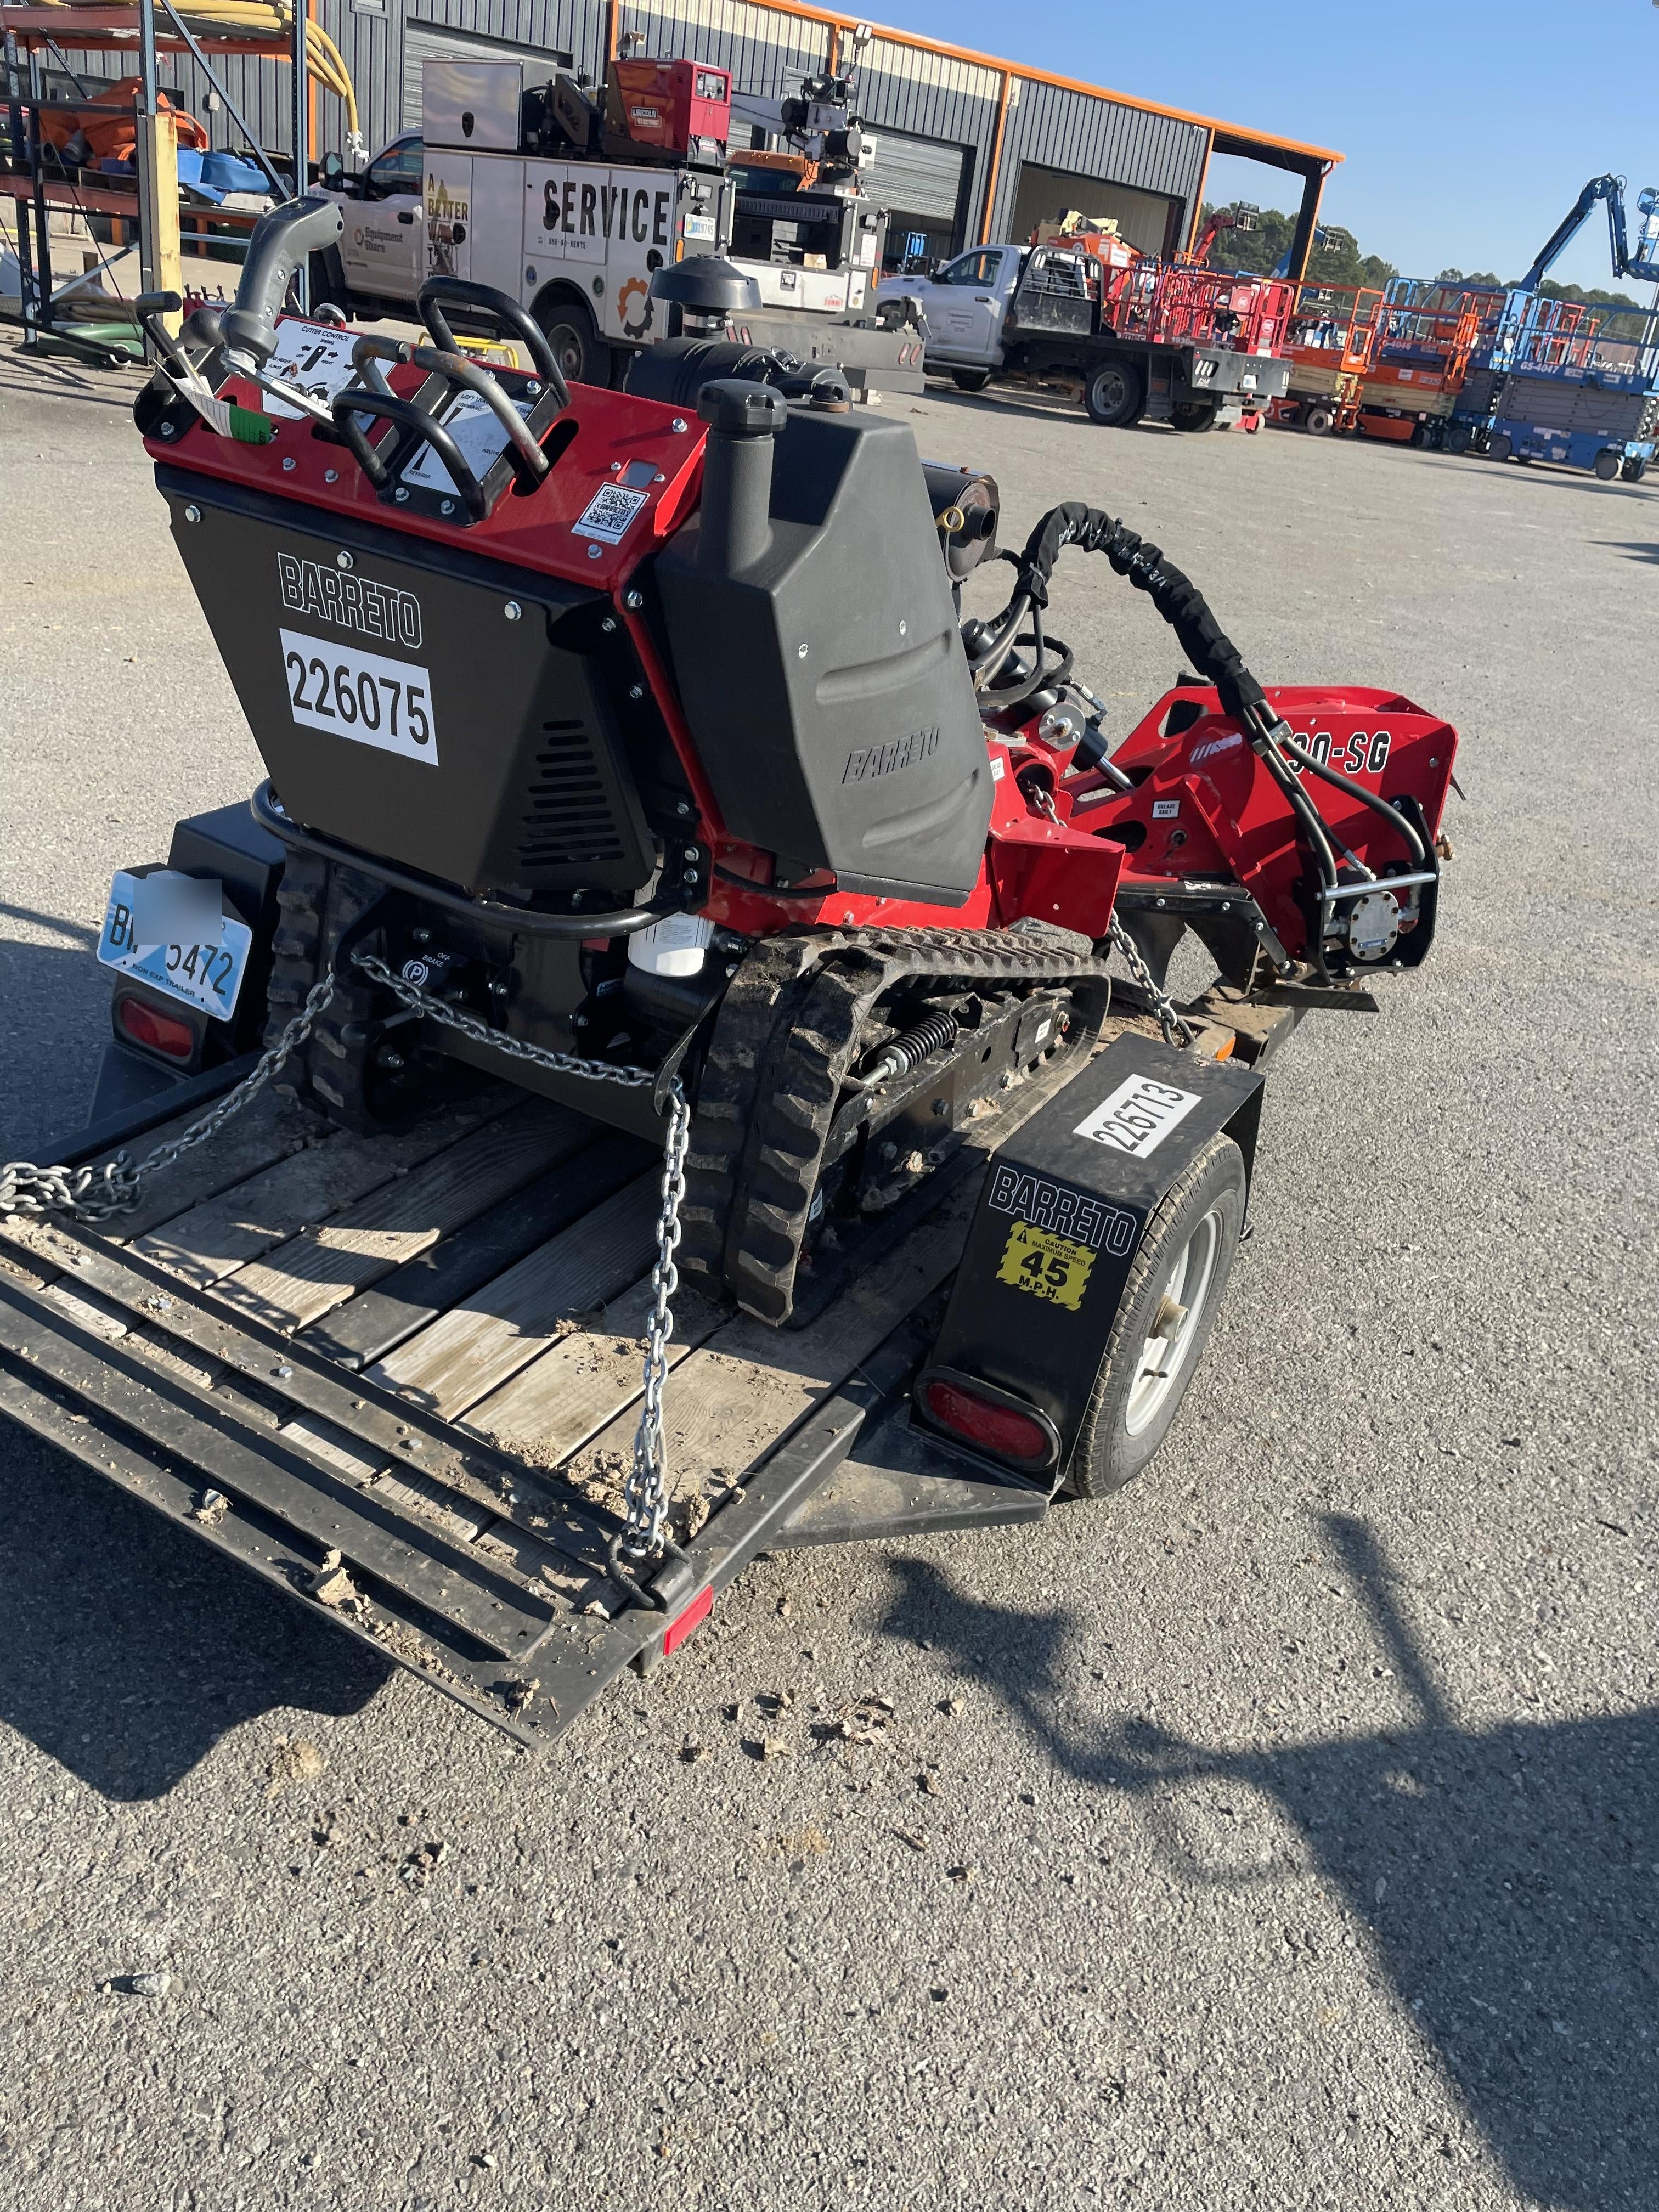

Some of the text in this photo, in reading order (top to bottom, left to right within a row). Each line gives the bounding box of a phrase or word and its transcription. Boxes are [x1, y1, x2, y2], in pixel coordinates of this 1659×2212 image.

[428, 173, 435, 192] A
[427, 198, 468, 221] BETTER
[543, 179, 670, 246] SERVICE
[302, 326, 349, 342] CUTTER CONTROL
[1520, 360, 1560, 374] GS-4047
[408, 470, 432, 479] REVERSE
[278, 552, 422, 648] BARRETO
[287, 651, 430, 745] 226075
[842, 726, 939, 784] BARRETO
[422, 955, 444, 968] BRAKE
[437, 952, 451, 961] OFF
[132, 963, 195, 998] NON EXP TRAILER
[1093, 1084, 1184, 1152] 226713
[988, 1165, 1137, 1257] BARRETO
[1031, 1240, 1086, 1266] MAXIMUM SPEED
[1045, 1239, 1077, 1256] CAUTION
[1020, 1250, 1070, 1287] 45
[1018, 1274, 1059, 1300] M.P.H.
